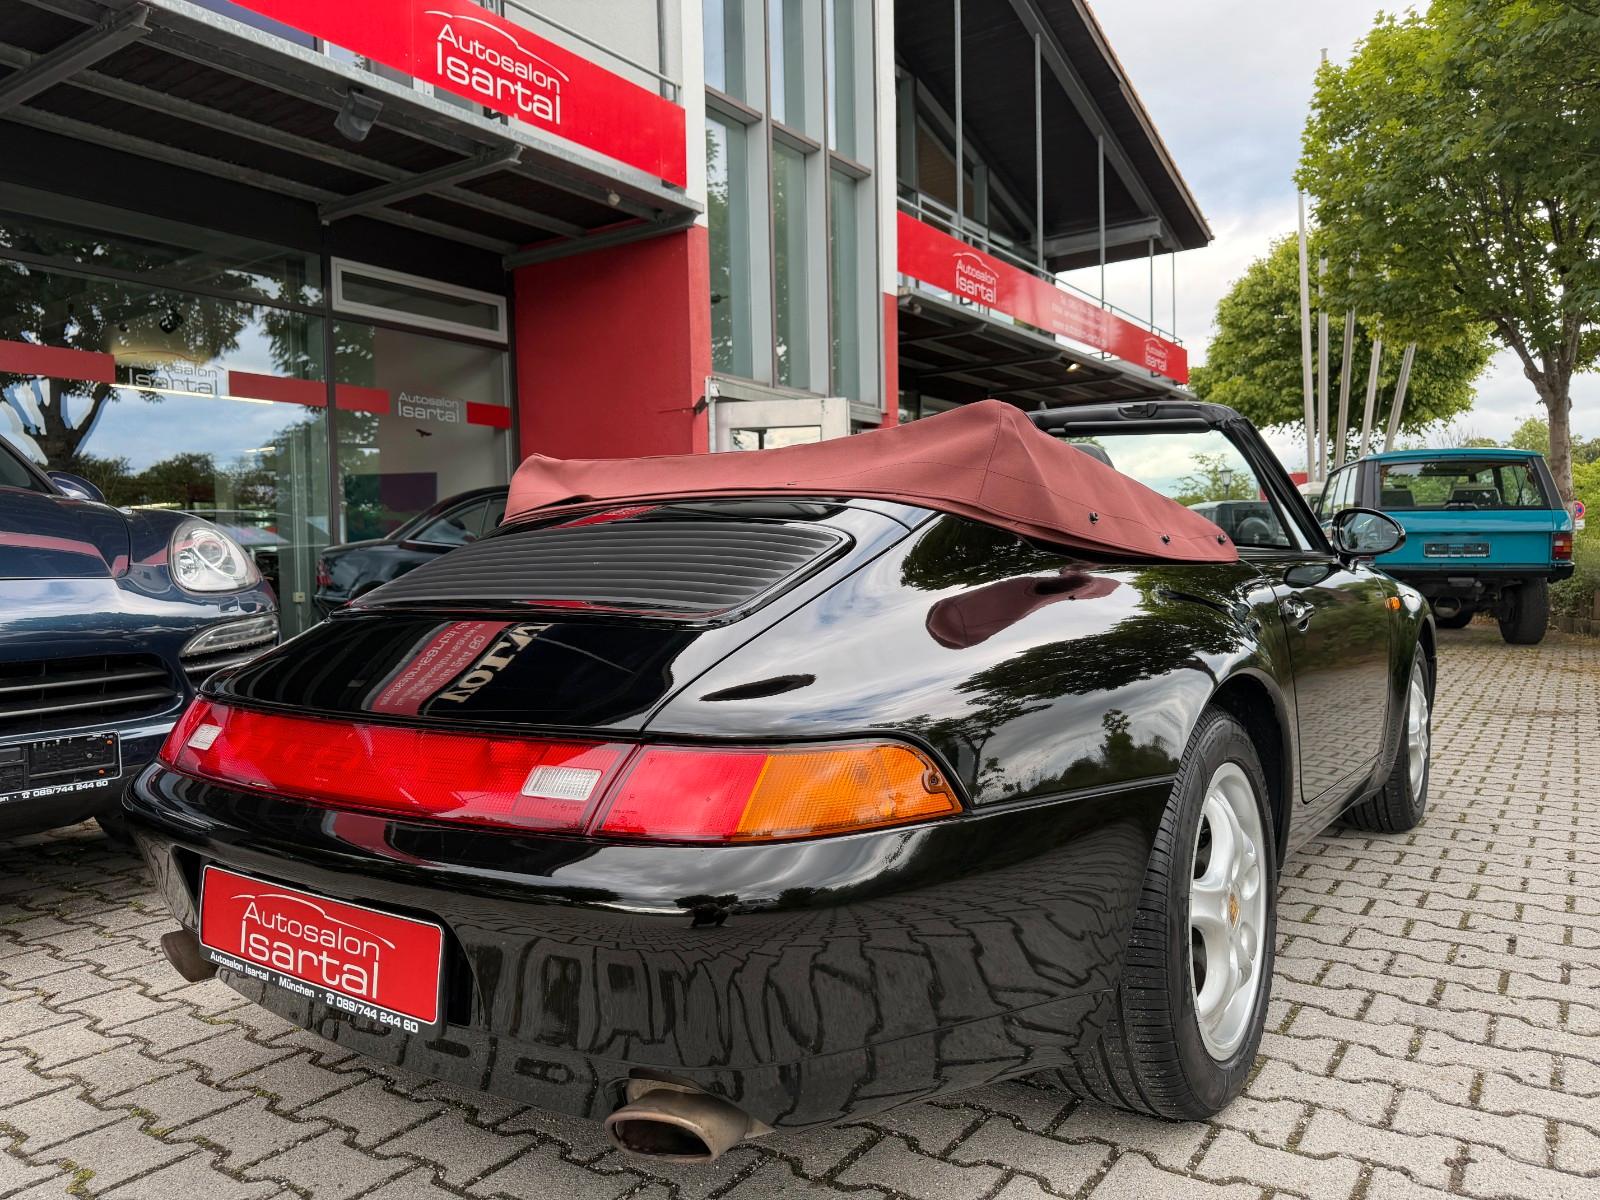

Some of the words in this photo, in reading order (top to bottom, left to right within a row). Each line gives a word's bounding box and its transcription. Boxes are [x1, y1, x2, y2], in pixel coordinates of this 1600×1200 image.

[438, 24, 560, 94] Autosalon
[437, 42, 560, 124] Isartal
[956, 259, 997, 287] Autosalon
[956, 270, 997, 304] Isartal
[129, 367, 217, 396] Isartal
[398, 401, 460, 424] Isartal
[399, 392, 460, 409] Autosalon
[33, 785, 73, 797] 089/744
[76, 782, 94, 791] 244
[96, 780, 108, 788] 60
[243, 902, 380, 961] Autosalon
[240, 920, 379, 999] Isartal
[210, 951, 243, 972] Autosalon
[245, 964, 270, 981] Isartal
[279, 976, 315, 998] München
[336, 996, 377, 1020] 089/744
[380, 1011, 401, 1028] 244
[403, 1019, 419, 1033] 60
